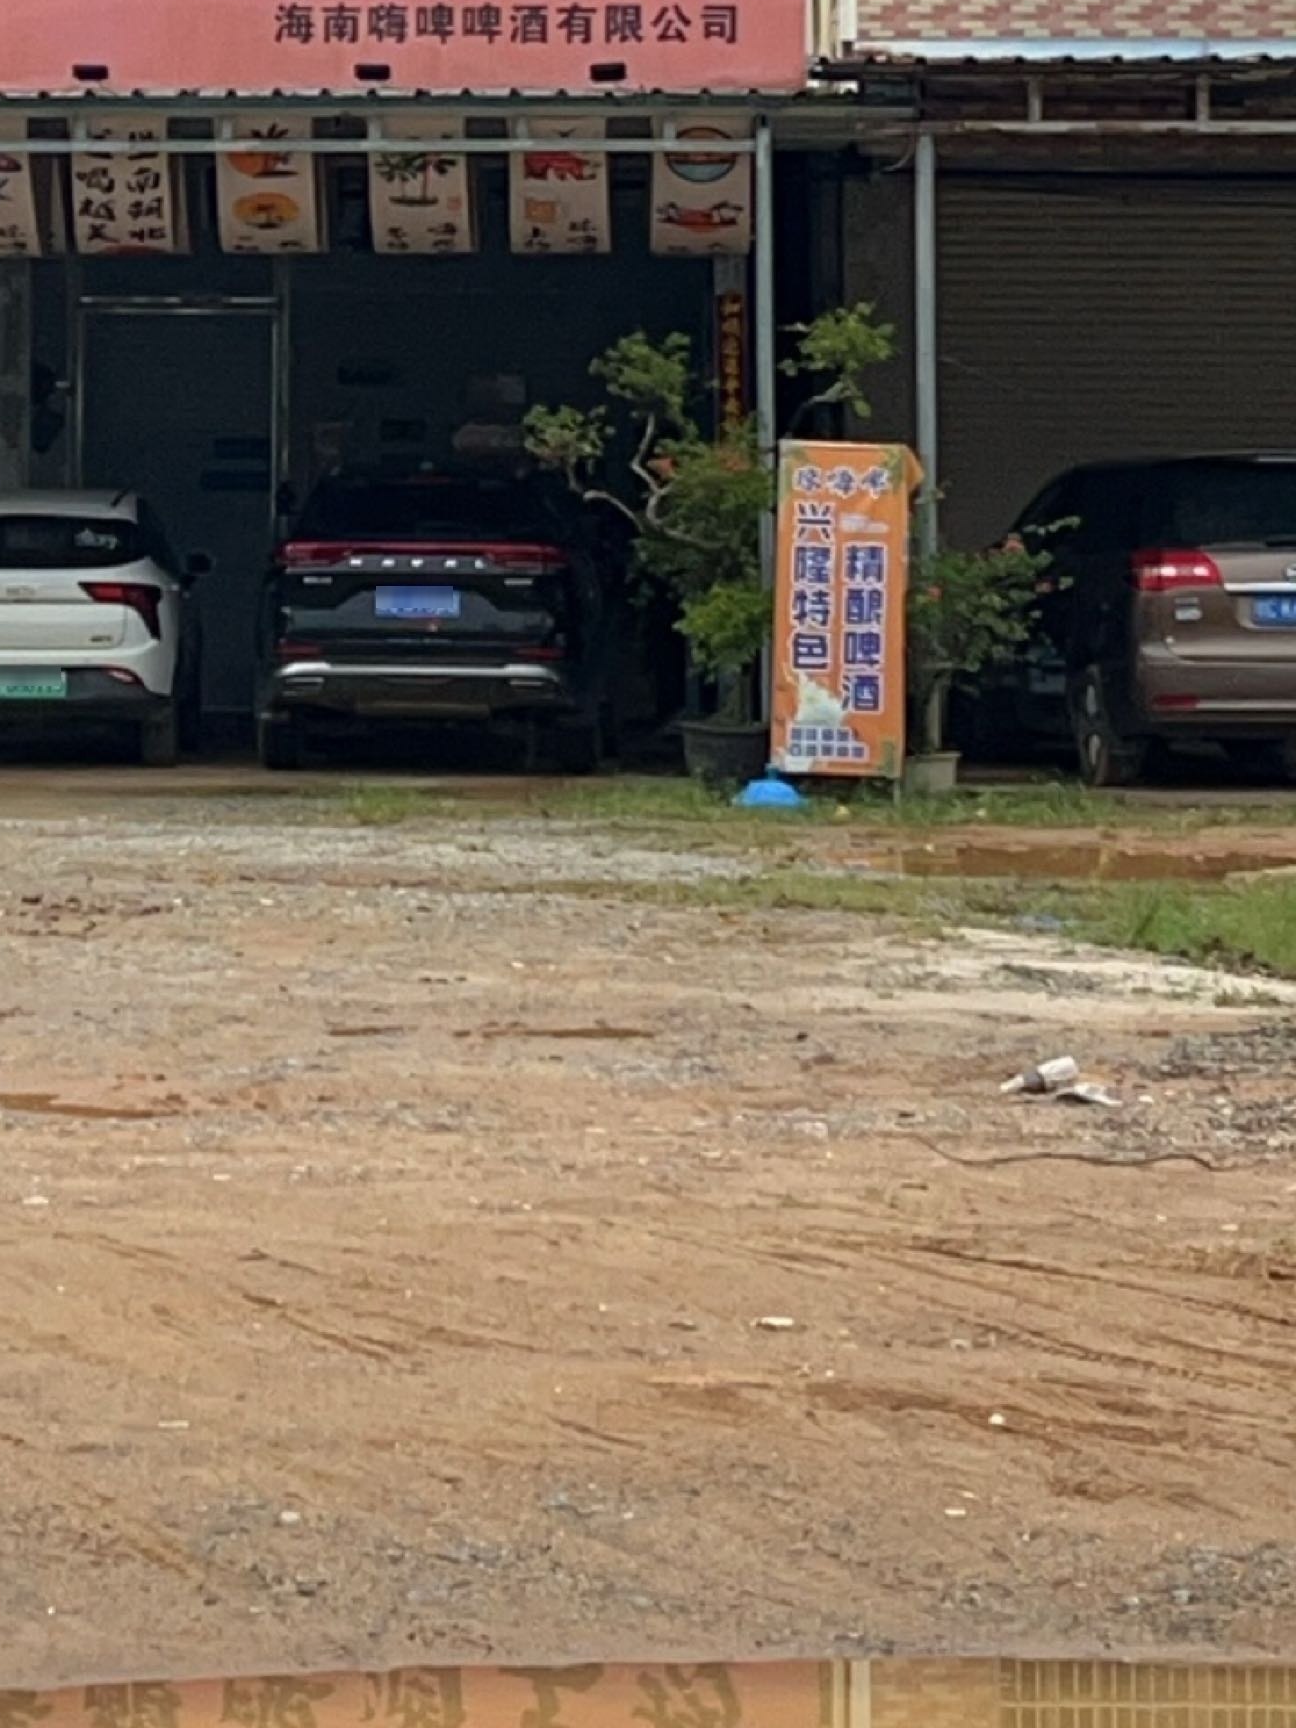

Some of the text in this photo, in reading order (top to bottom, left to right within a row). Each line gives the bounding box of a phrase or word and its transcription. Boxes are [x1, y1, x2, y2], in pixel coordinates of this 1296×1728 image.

[275, 3, 739, 44] 海南嗨啤啤酒有限公司
[792, 503, 832, 669] 兴隆特色
[842, 545, 886, 712] 精酿啤酒
